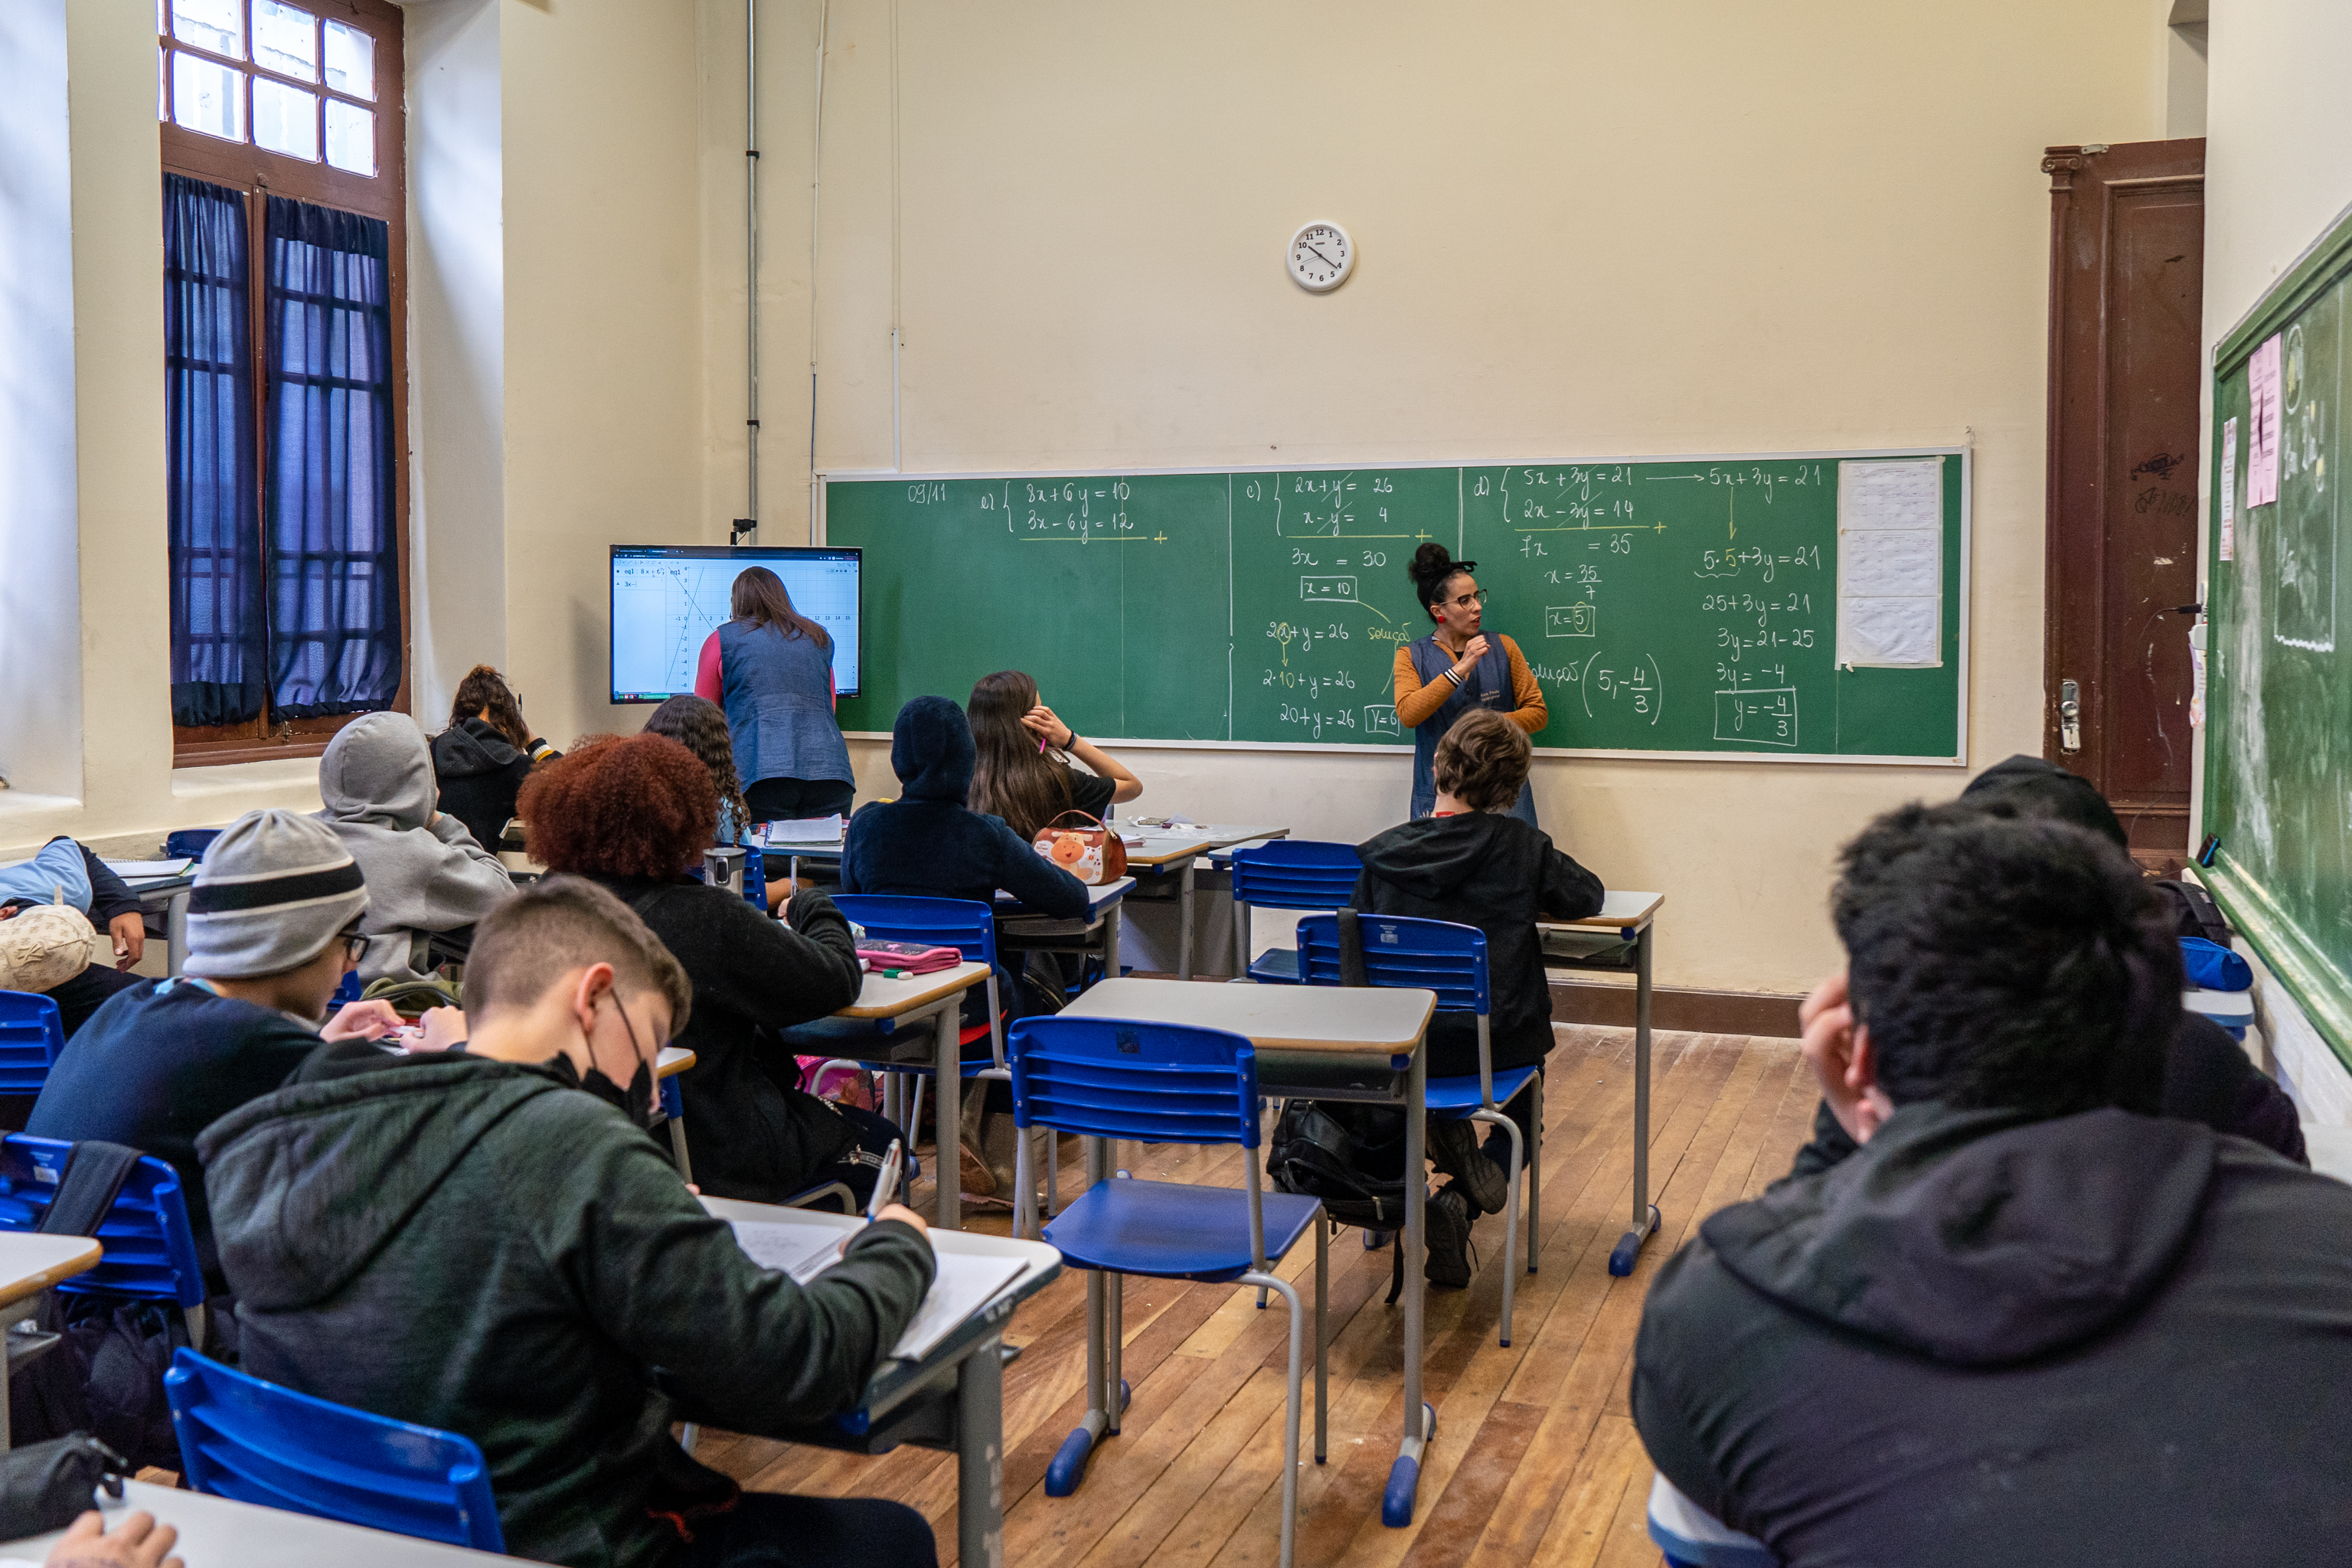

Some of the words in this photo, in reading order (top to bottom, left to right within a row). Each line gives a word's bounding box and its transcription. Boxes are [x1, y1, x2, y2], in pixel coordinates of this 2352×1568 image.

[908, 482, 946, 505] 09/11
[1374, 478, 1393, 493] 26
[1379, 508, 1387, 523] 4
[1610, 534, 1634, 554] 35
[1363, 550, 1387, 567] 30
